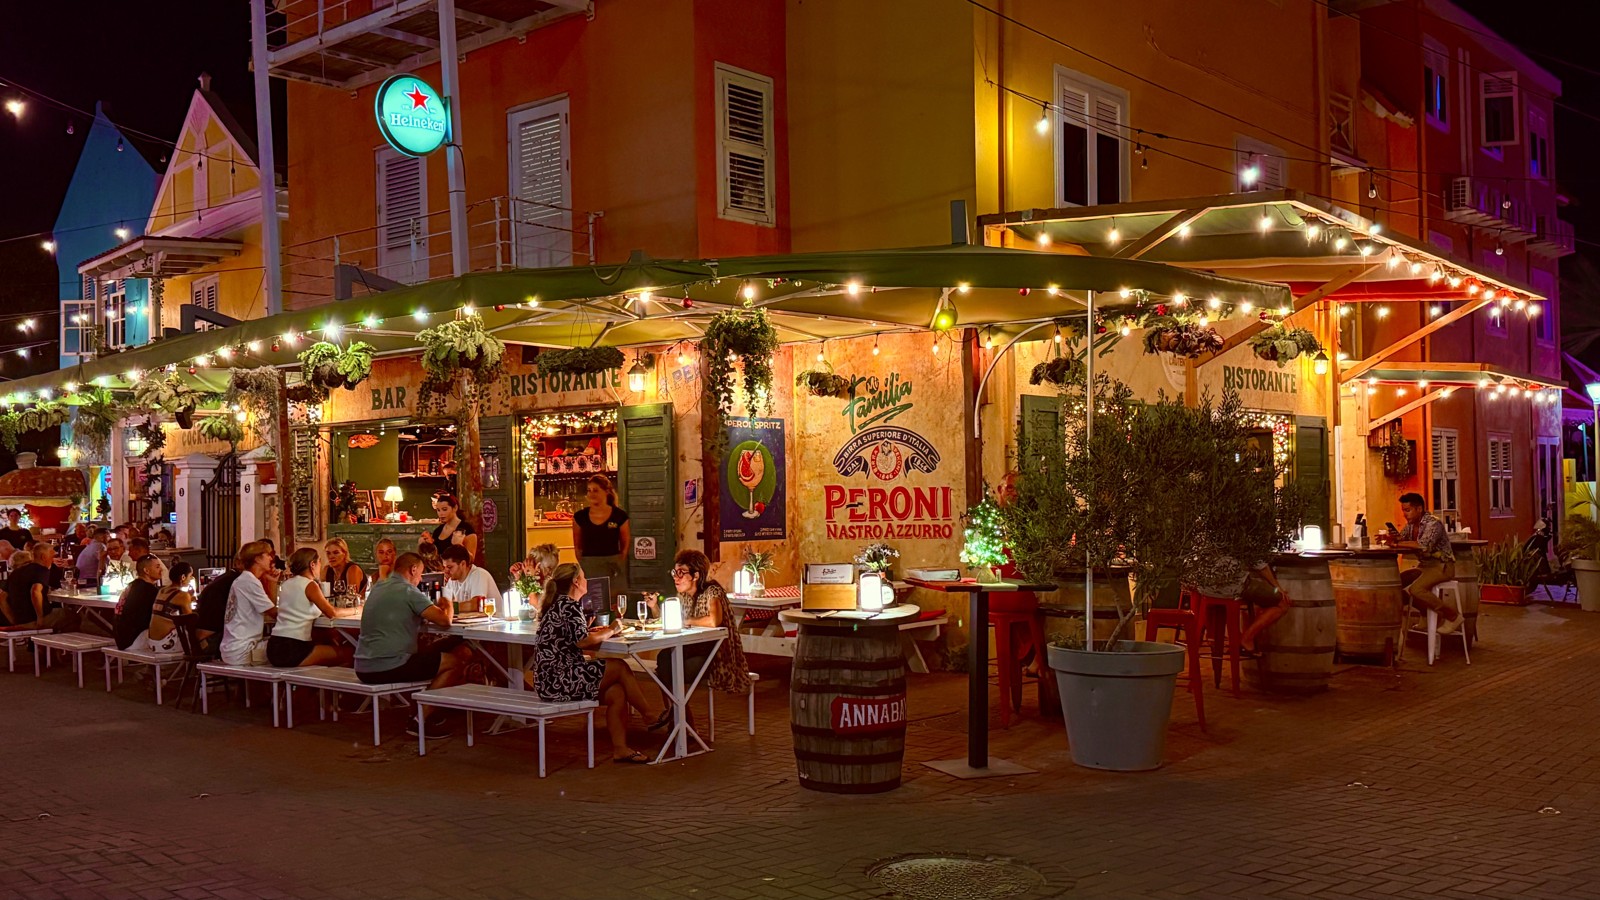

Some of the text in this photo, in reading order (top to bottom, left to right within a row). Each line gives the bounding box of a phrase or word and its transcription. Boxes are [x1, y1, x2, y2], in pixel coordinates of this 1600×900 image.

[391, 113, 444, 132] Heineken
[510, 367, 621, 397] RISTORANTE
[1223, 365, 1297, 394] RISTORANTE
[371, 386, 406, 411] BAR
[842, 372, 913, 434] Familia
[754, 421, 781, 429] SPRITZ
[843, 431, 930, 459] BIRRA SUPERIORE D'ITALIA
[846, 460, 860, 473] DAL
[824, 485, 953, 522] PERONI
[826, 522, 953, 540] NASTRO AZZURRO
[635, 547, 655, 556] PERONI
